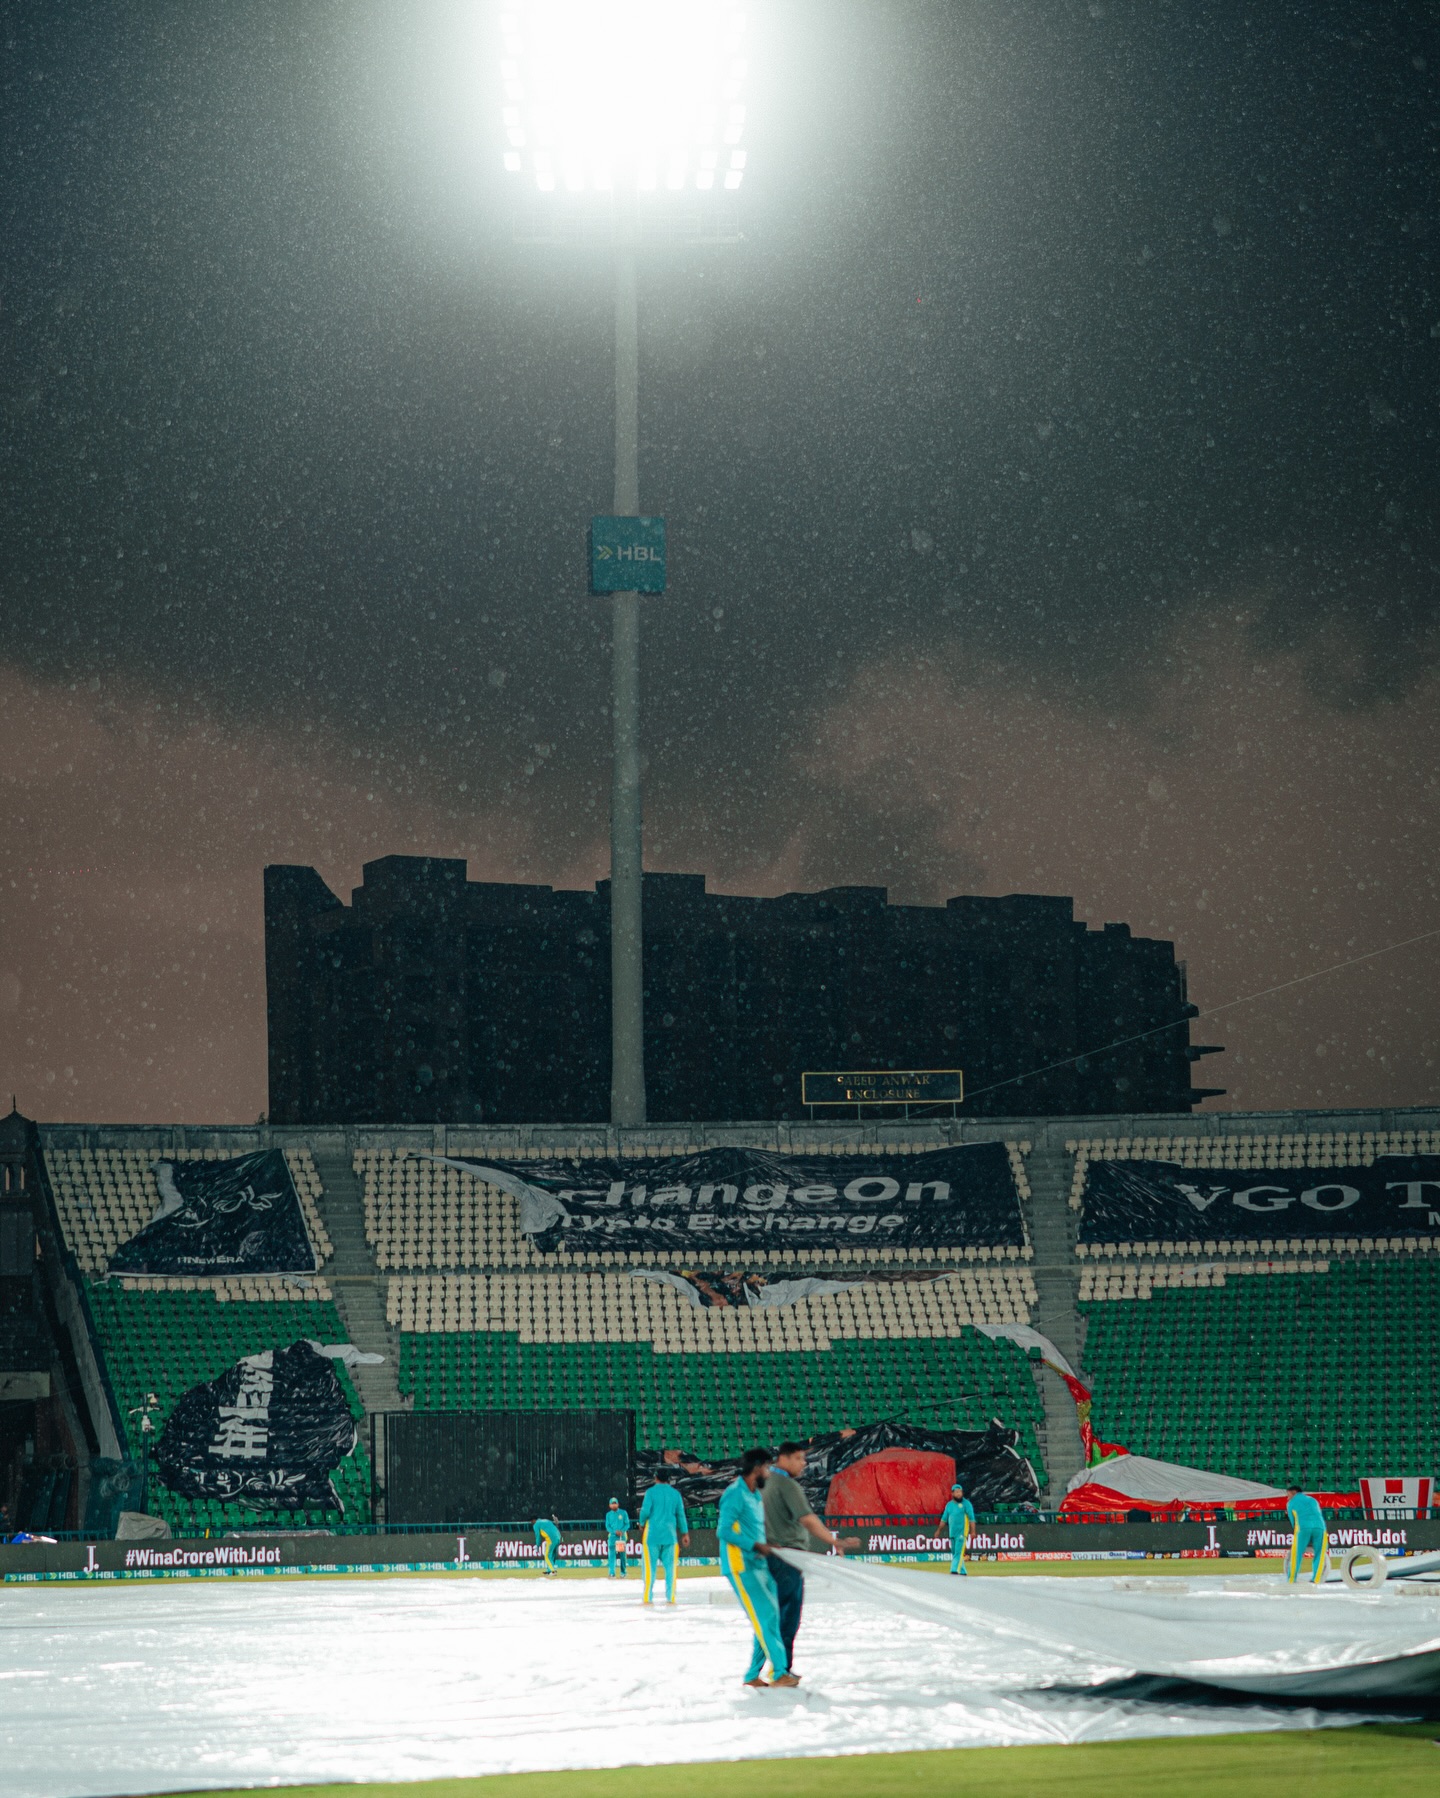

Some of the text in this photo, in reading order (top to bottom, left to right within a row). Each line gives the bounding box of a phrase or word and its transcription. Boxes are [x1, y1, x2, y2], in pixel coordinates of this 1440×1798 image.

[617, 545, 662, 561] HBL
[837, 1074, 930, 1086] SAEED ANWAR
[846, 1089, 921, 1100] ENCLOSURE
[1173, 1184, 1360, 1212] VGO
[688, 1213, 904, 1233] Exchange
[1383, 1495, 1407, 1504] KFC
[126, 1546, 280, 1567] #WinaCroreWithJdot
[864, 1555, 885, 1563] HBL
[428, 1562, 447, 1570] HBL
[501, 1560, 521, 1568] HBL
[574, 1559, 593, 1567] HBL
[682, 1558, 703, 1566] HBL
[59, 1571, 79, 1579] HBL
[96, 1571, 117, 1579] HBL
[208, 1568, 228, 1576] HBL
